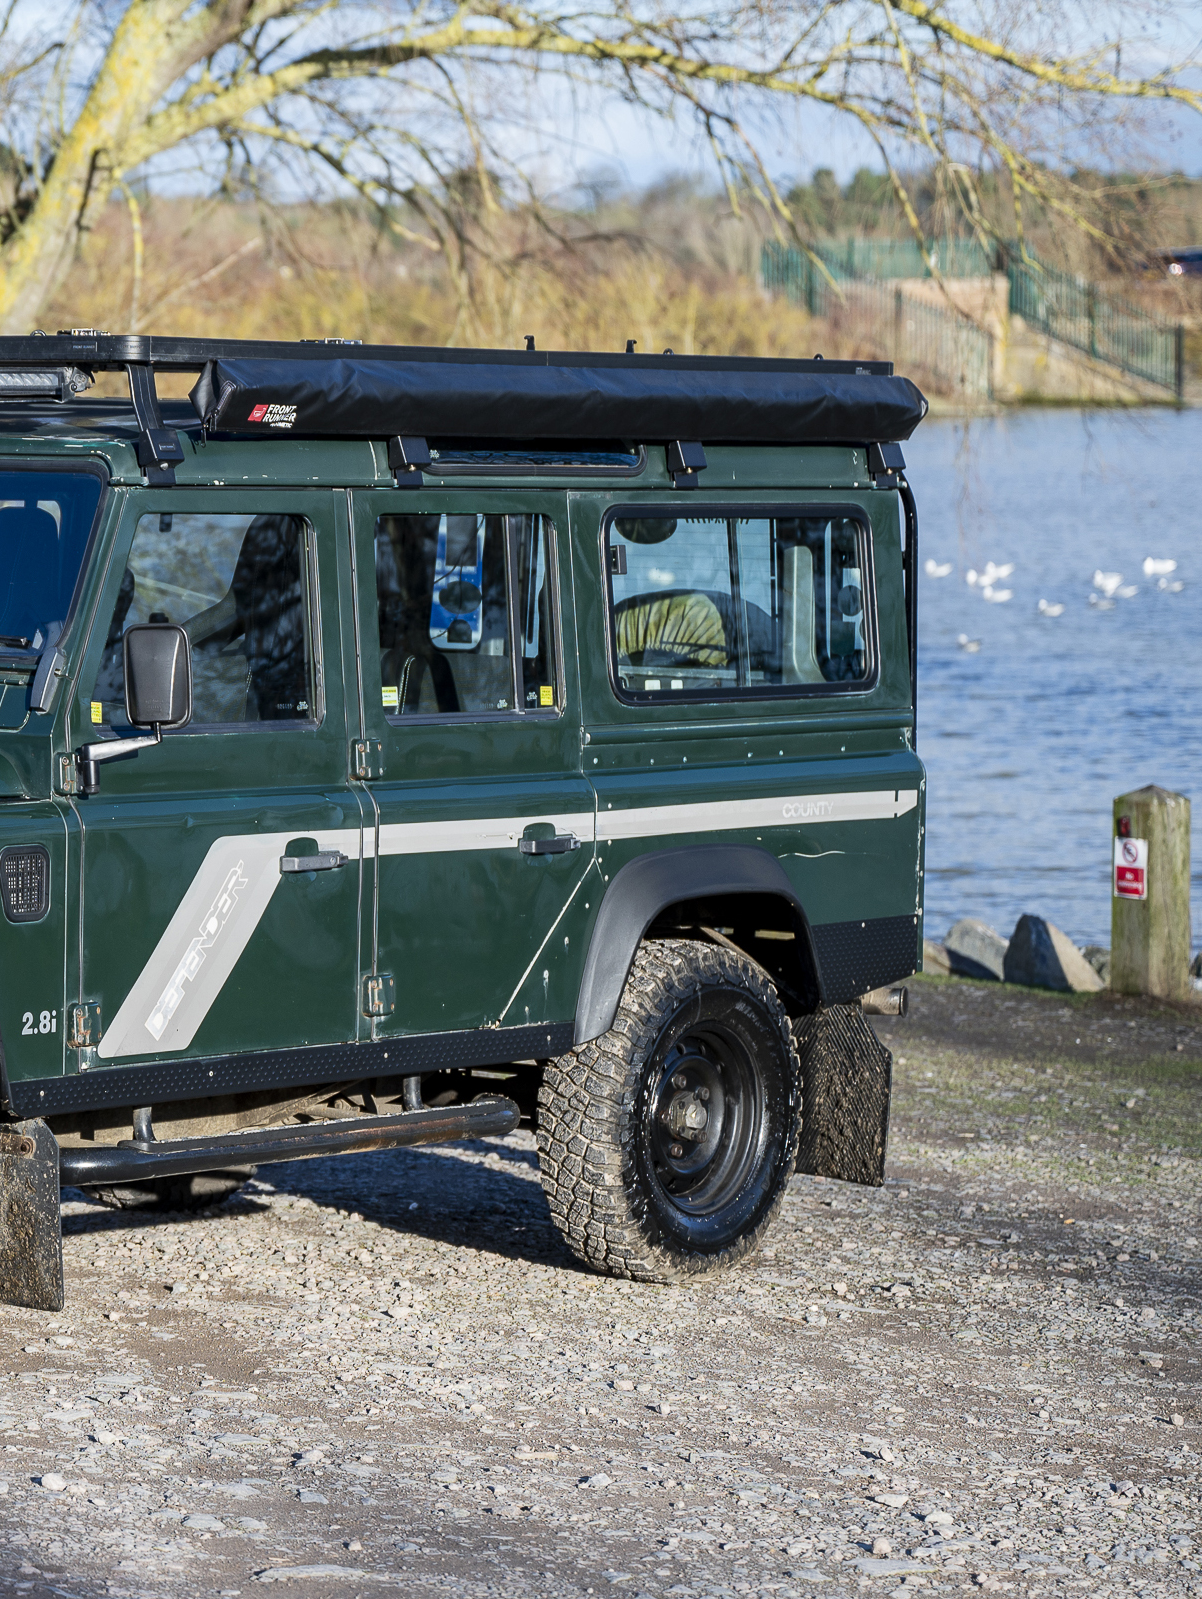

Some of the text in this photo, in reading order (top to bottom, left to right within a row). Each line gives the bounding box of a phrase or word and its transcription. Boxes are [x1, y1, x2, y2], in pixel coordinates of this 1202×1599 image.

[262, 412, 297, 422] RUNNER
[267, 404, 298, 413] FRONT
[782, 801, 834, 819] COUNTY
[144, 859, 249, 1042] DEFENDER
[21, 1009, 57, 1036] 2.8i
